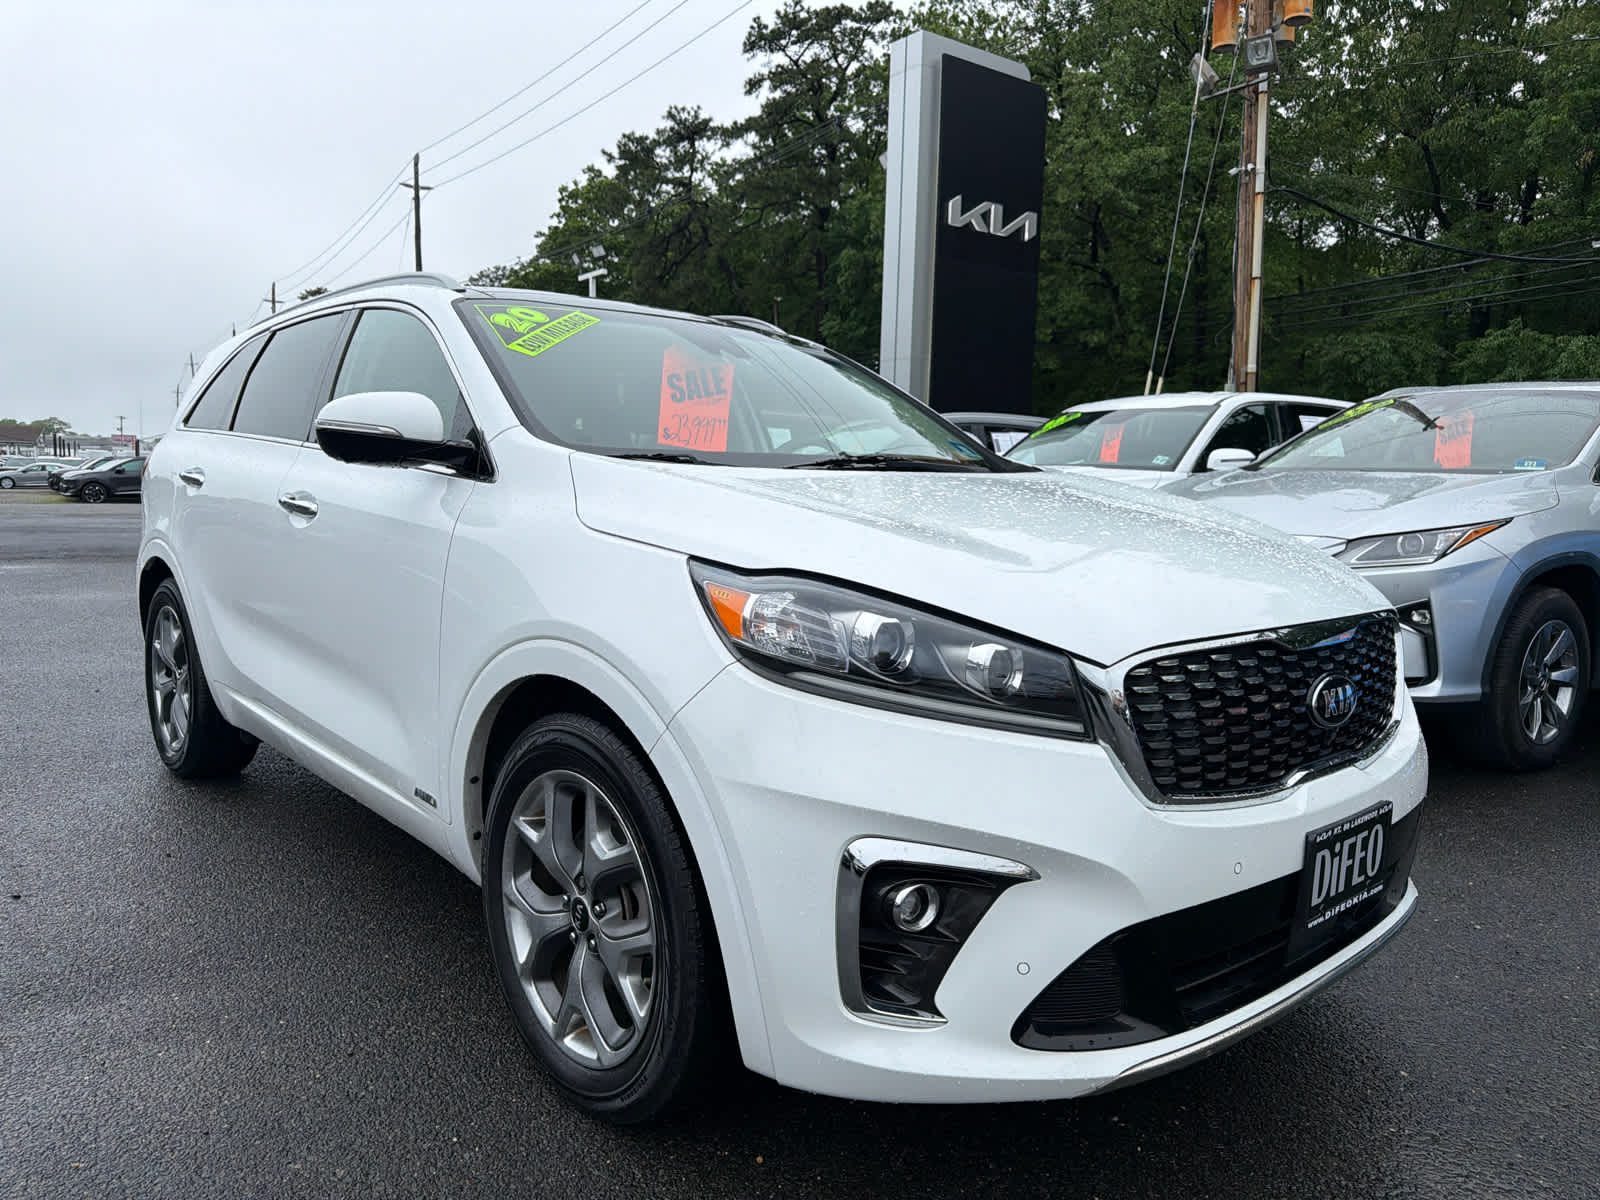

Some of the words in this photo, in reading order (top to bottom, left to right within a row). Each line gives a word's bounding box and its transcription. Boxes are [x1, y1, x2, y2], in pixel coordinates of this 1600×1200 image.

[947, 193, 1038, 243] KIA
[490, 306, 550, 334] 20
[516, 334, 553, 353] LOW
[540, 313, 590, 340] MILEAGE
[667, 365, 728, 404] SALE
[1322, 685, 1355, 719] KIA
[1311, 823, 1384, 908] DiFEO
